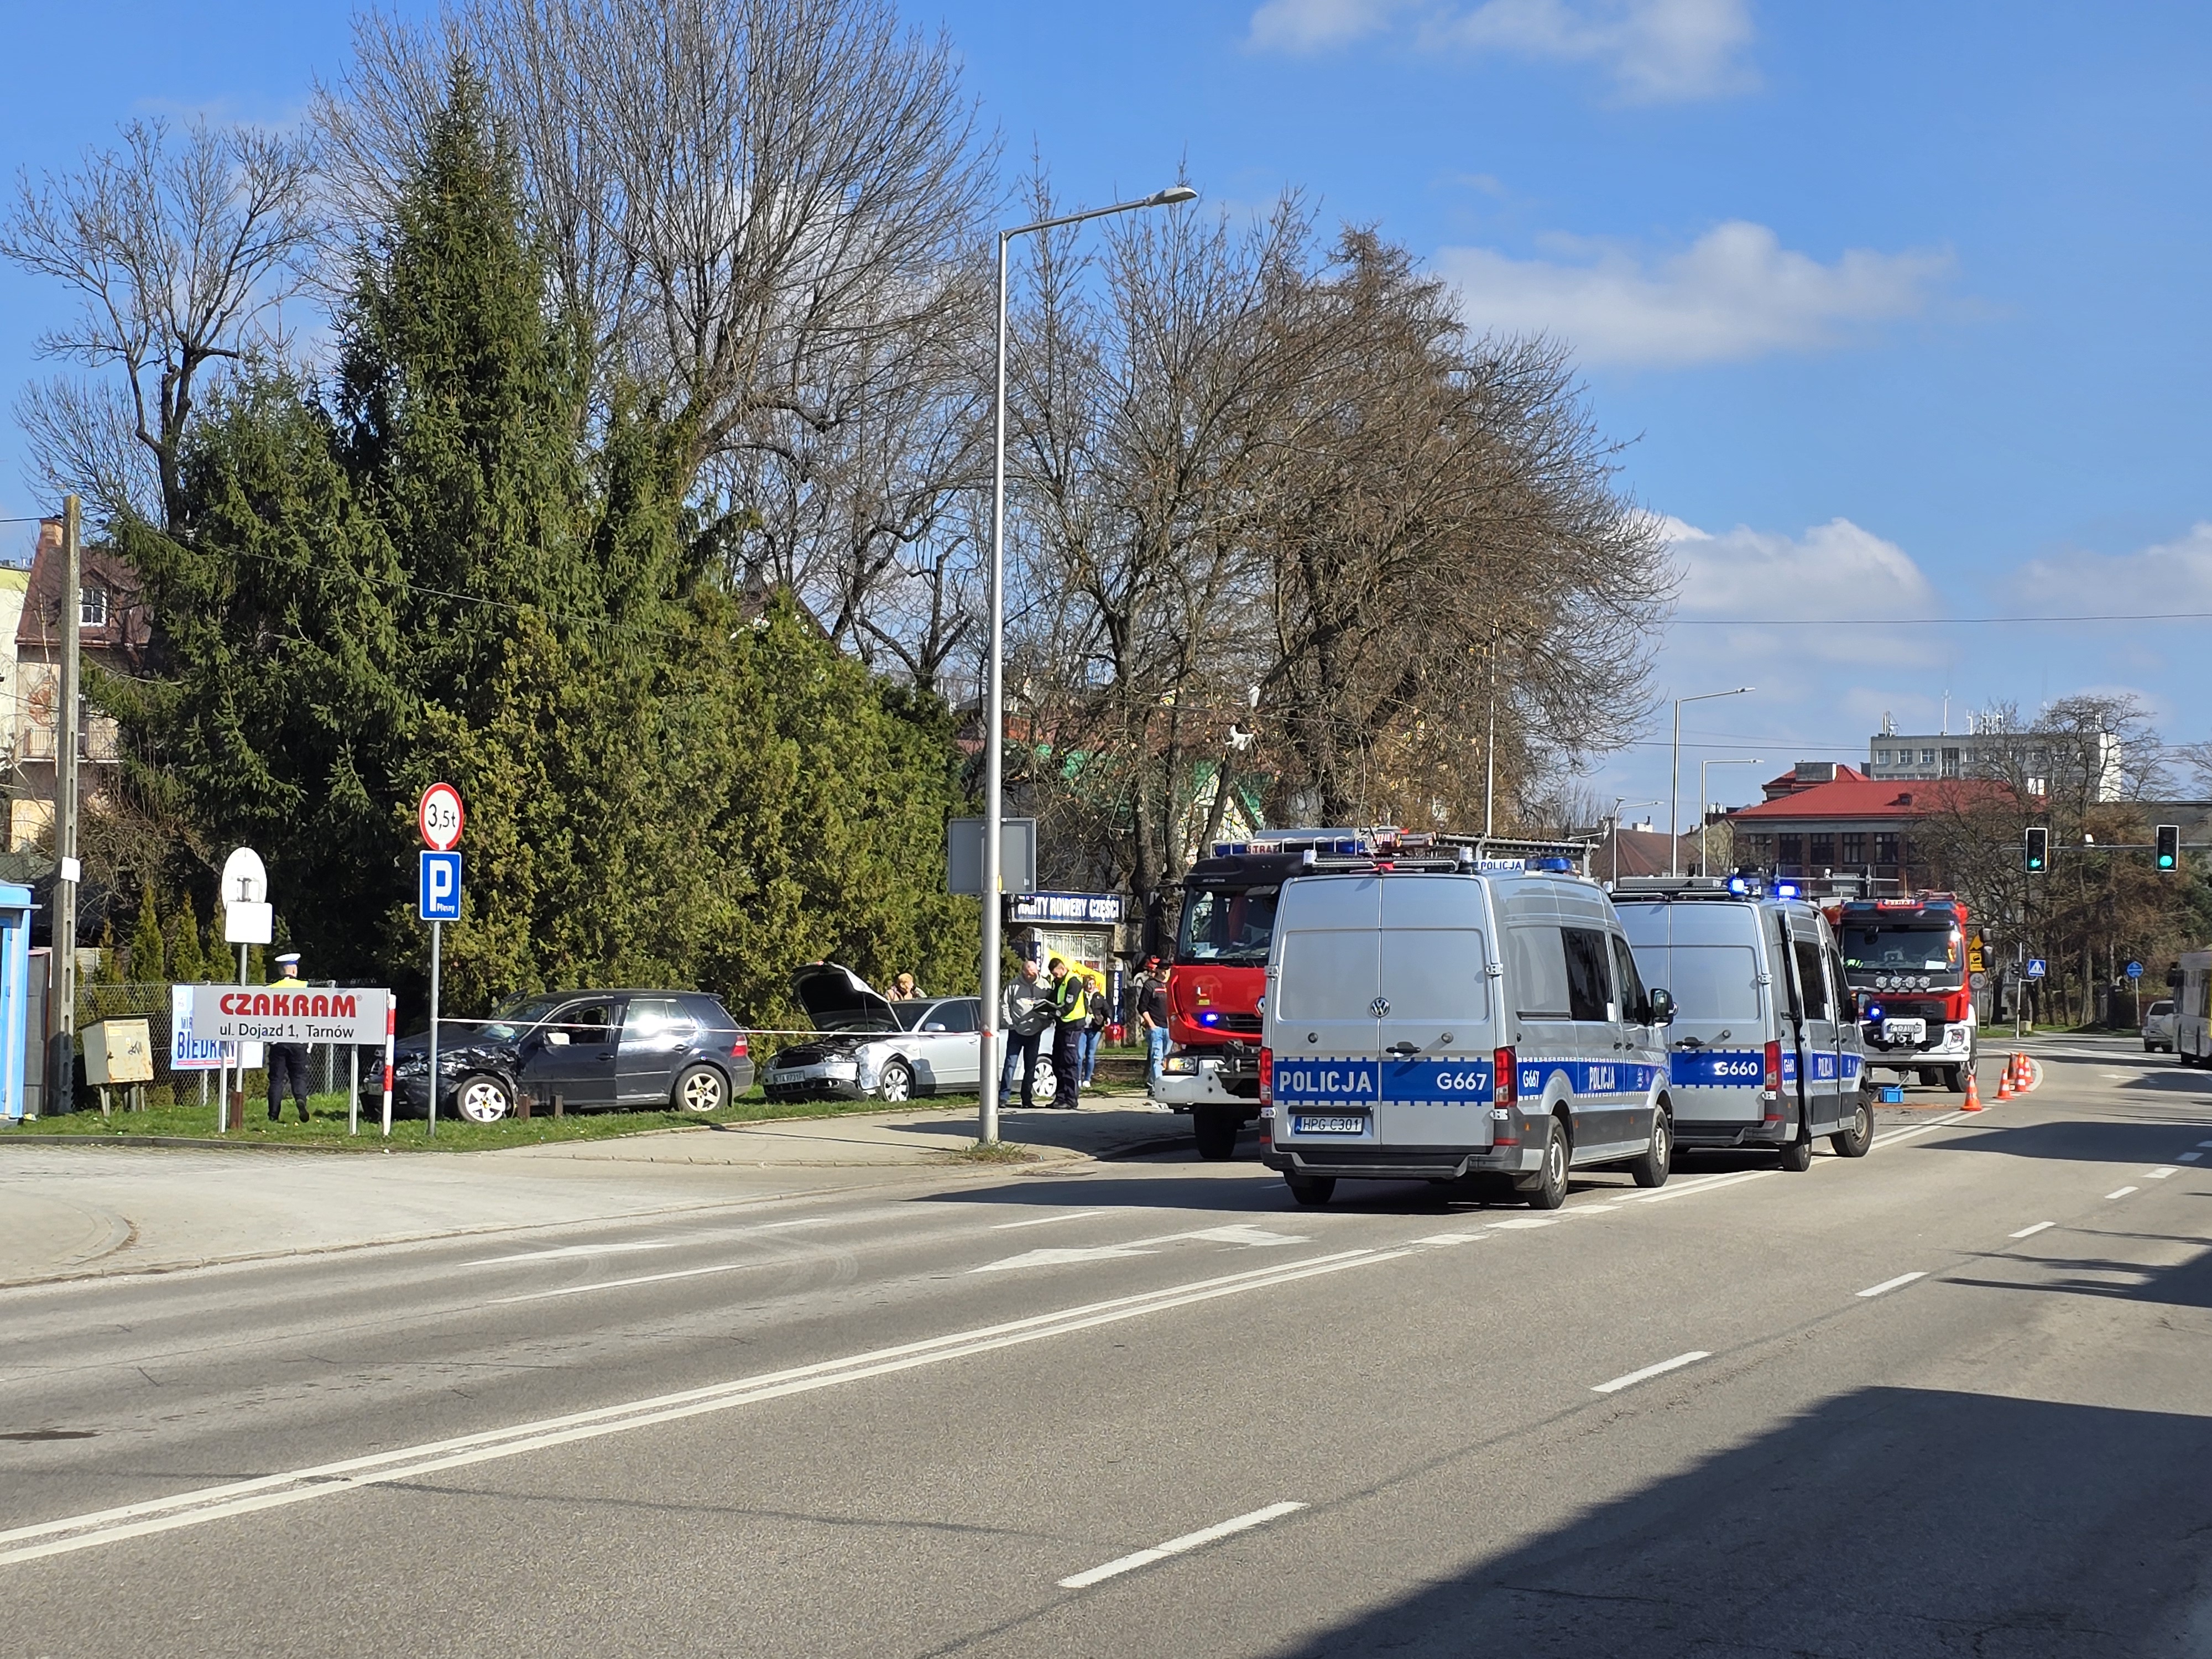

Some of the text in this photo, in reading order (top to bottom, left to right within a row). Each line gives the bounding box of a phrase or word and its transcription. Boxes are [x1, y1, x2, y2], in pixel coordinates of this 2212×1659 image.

[1480, 860, 1522, 870] POLICJA
[429, 859, 452, 911] P
[220, 993, 356, 1018] CZAKRAM
[220, 1023, 354, 1039] ul. Dojazd 1, Tarnów
[1713, 1061, 1758, 1076] G660
[1279, 1071, 1373, 1092] POLICJA
[1437, 1072, 1487, 1091] G667
[1522, 1070, 1540, 1088] G667
[1589, 1066, 1615, 1090] POLICJA
[1303, 1118, 1359, 1130] HPG C301
